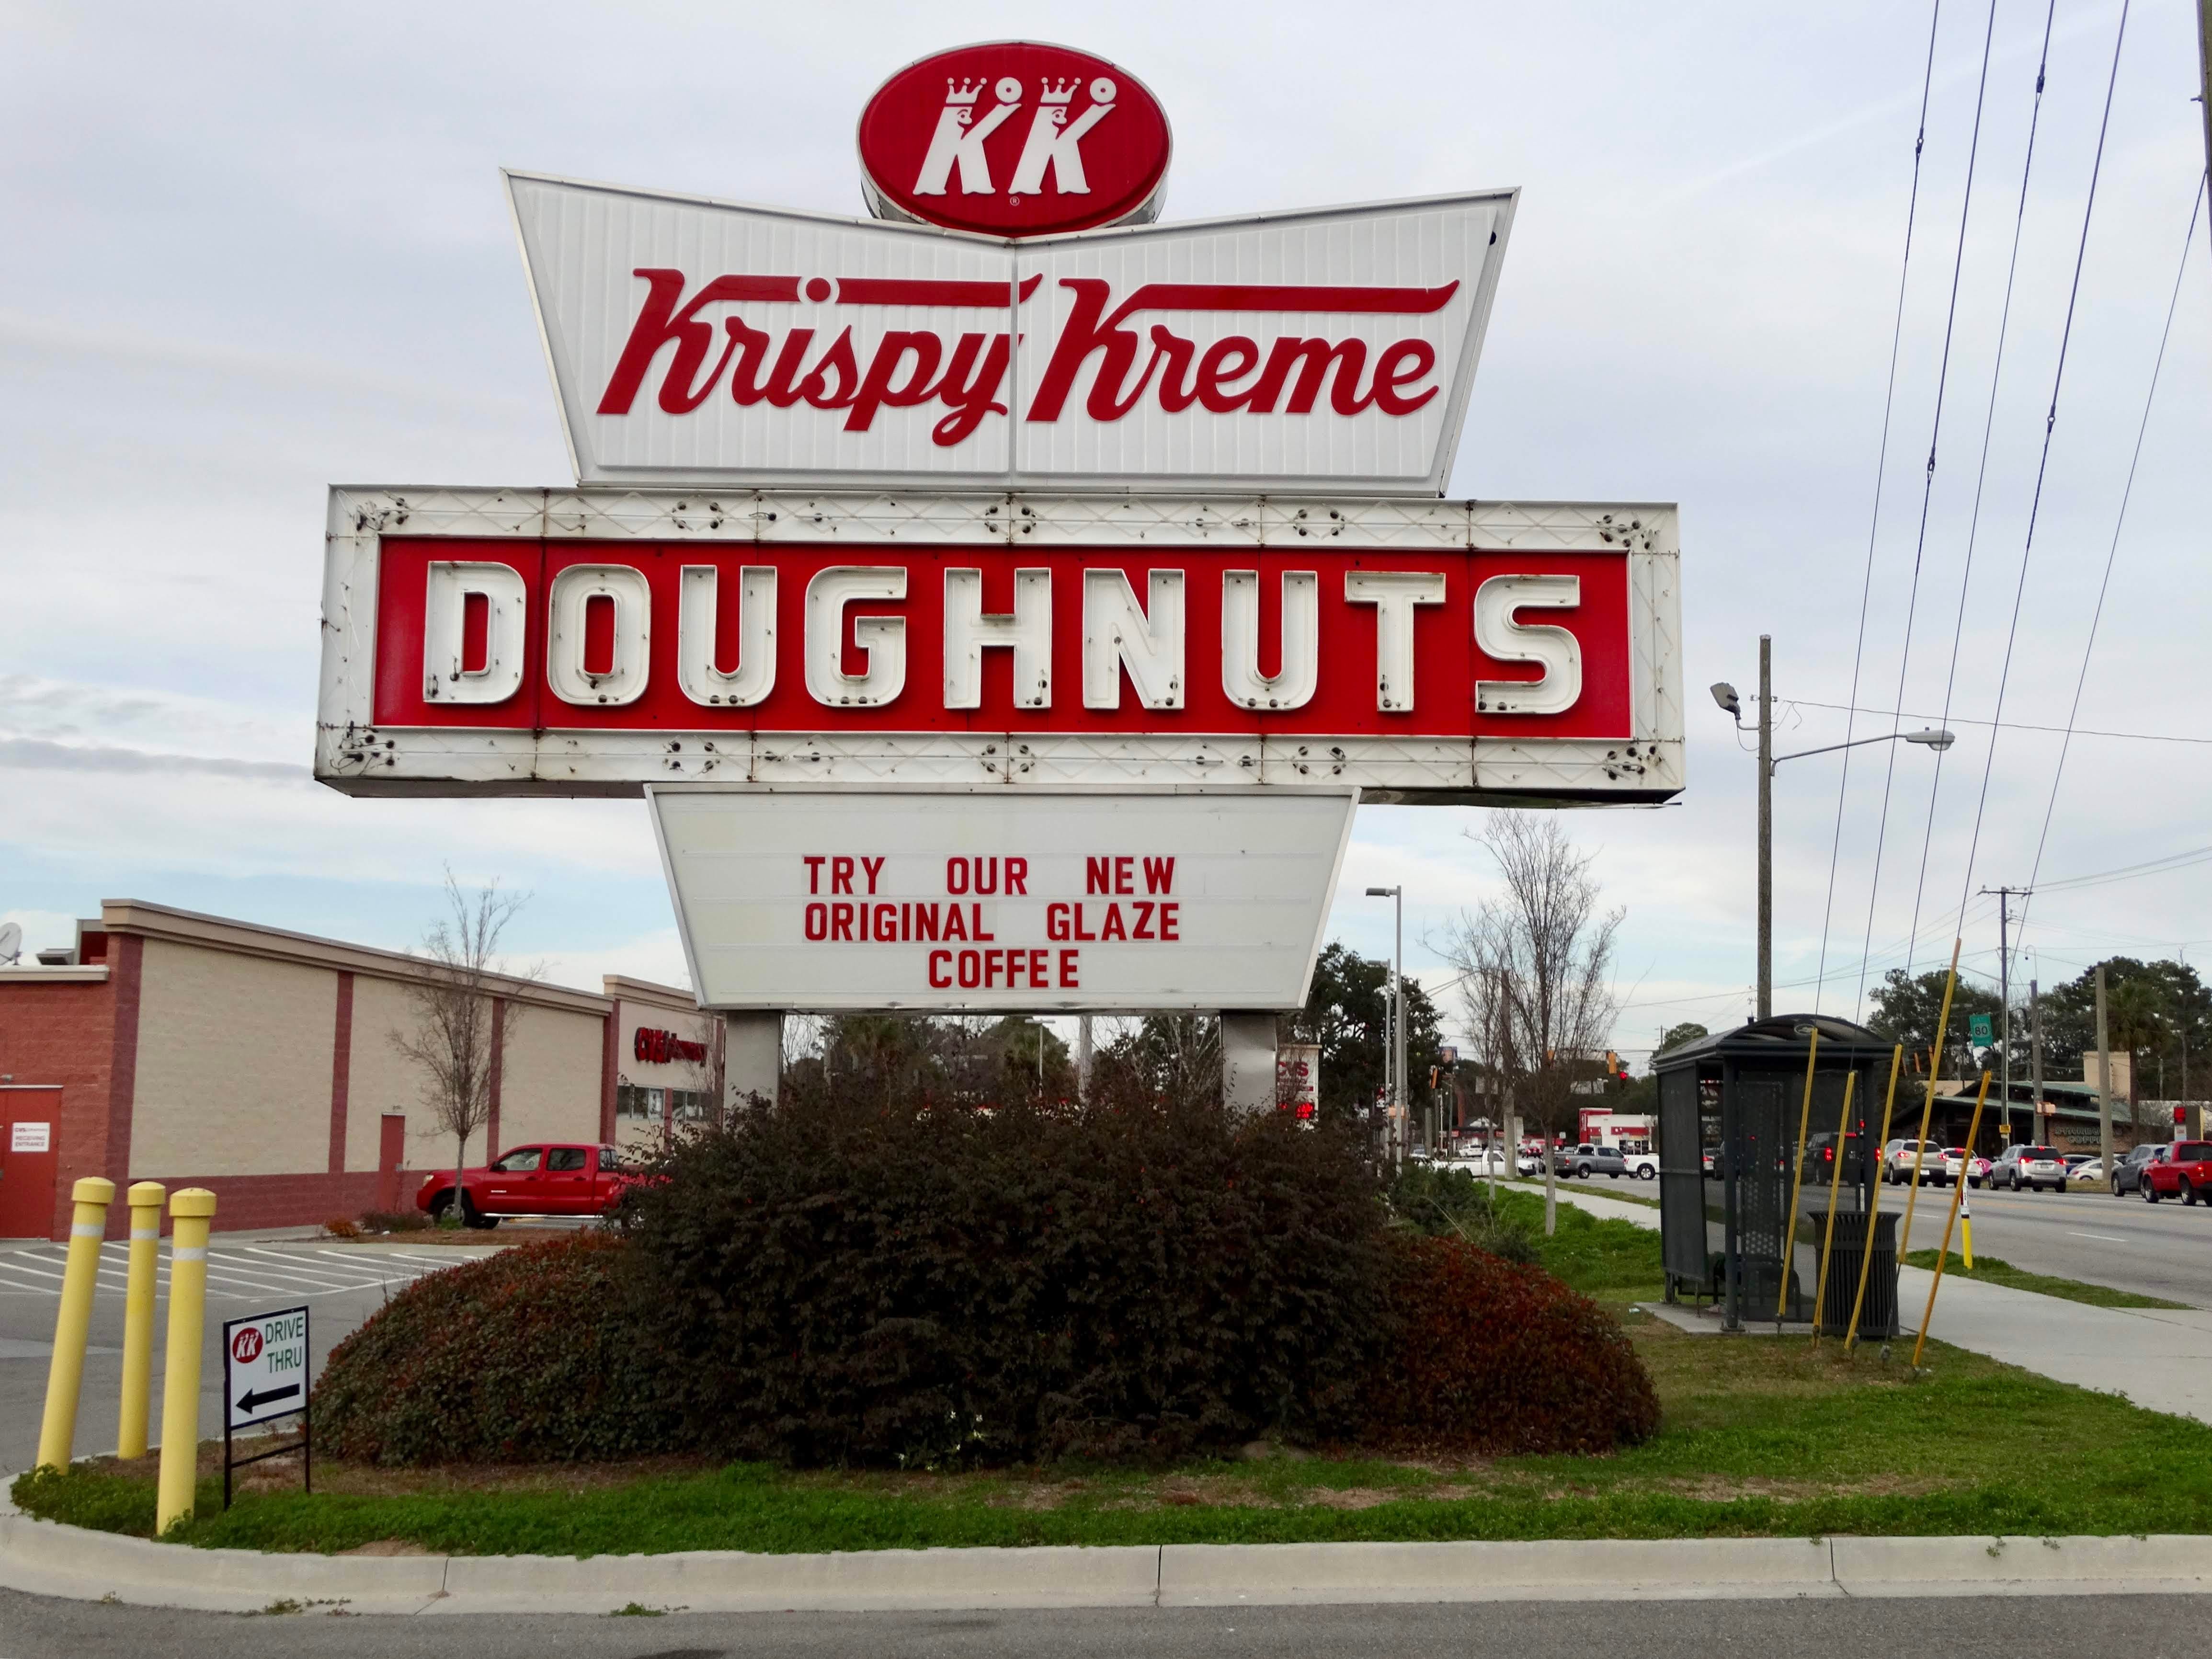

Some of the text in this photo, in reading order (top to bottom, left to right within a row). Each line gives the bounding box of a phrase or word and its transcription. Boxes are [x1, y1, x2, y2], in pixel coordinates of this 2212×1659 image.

[913, 77, 1117, 195] KK
[596, 268, 1460, 447] Krispy Kreme
[423, 561, 1582, 714] DOUGHNUTS
[804, 857, 1175, 895] TRY OUR NEW
[805, 902, 1179, 942] ORIGINAL GLAZE
[928, 949, 1079, 988] COFFEE
[1975, 1026, 1987, 1035] 80
[2054, 1126, 2123, 1135] STARBUS
[2067, 1135, 2101, 1144] COFF
[265, 1316, 304, 1344] DRIVE
[267, 1346, 302, 1373] THRU
